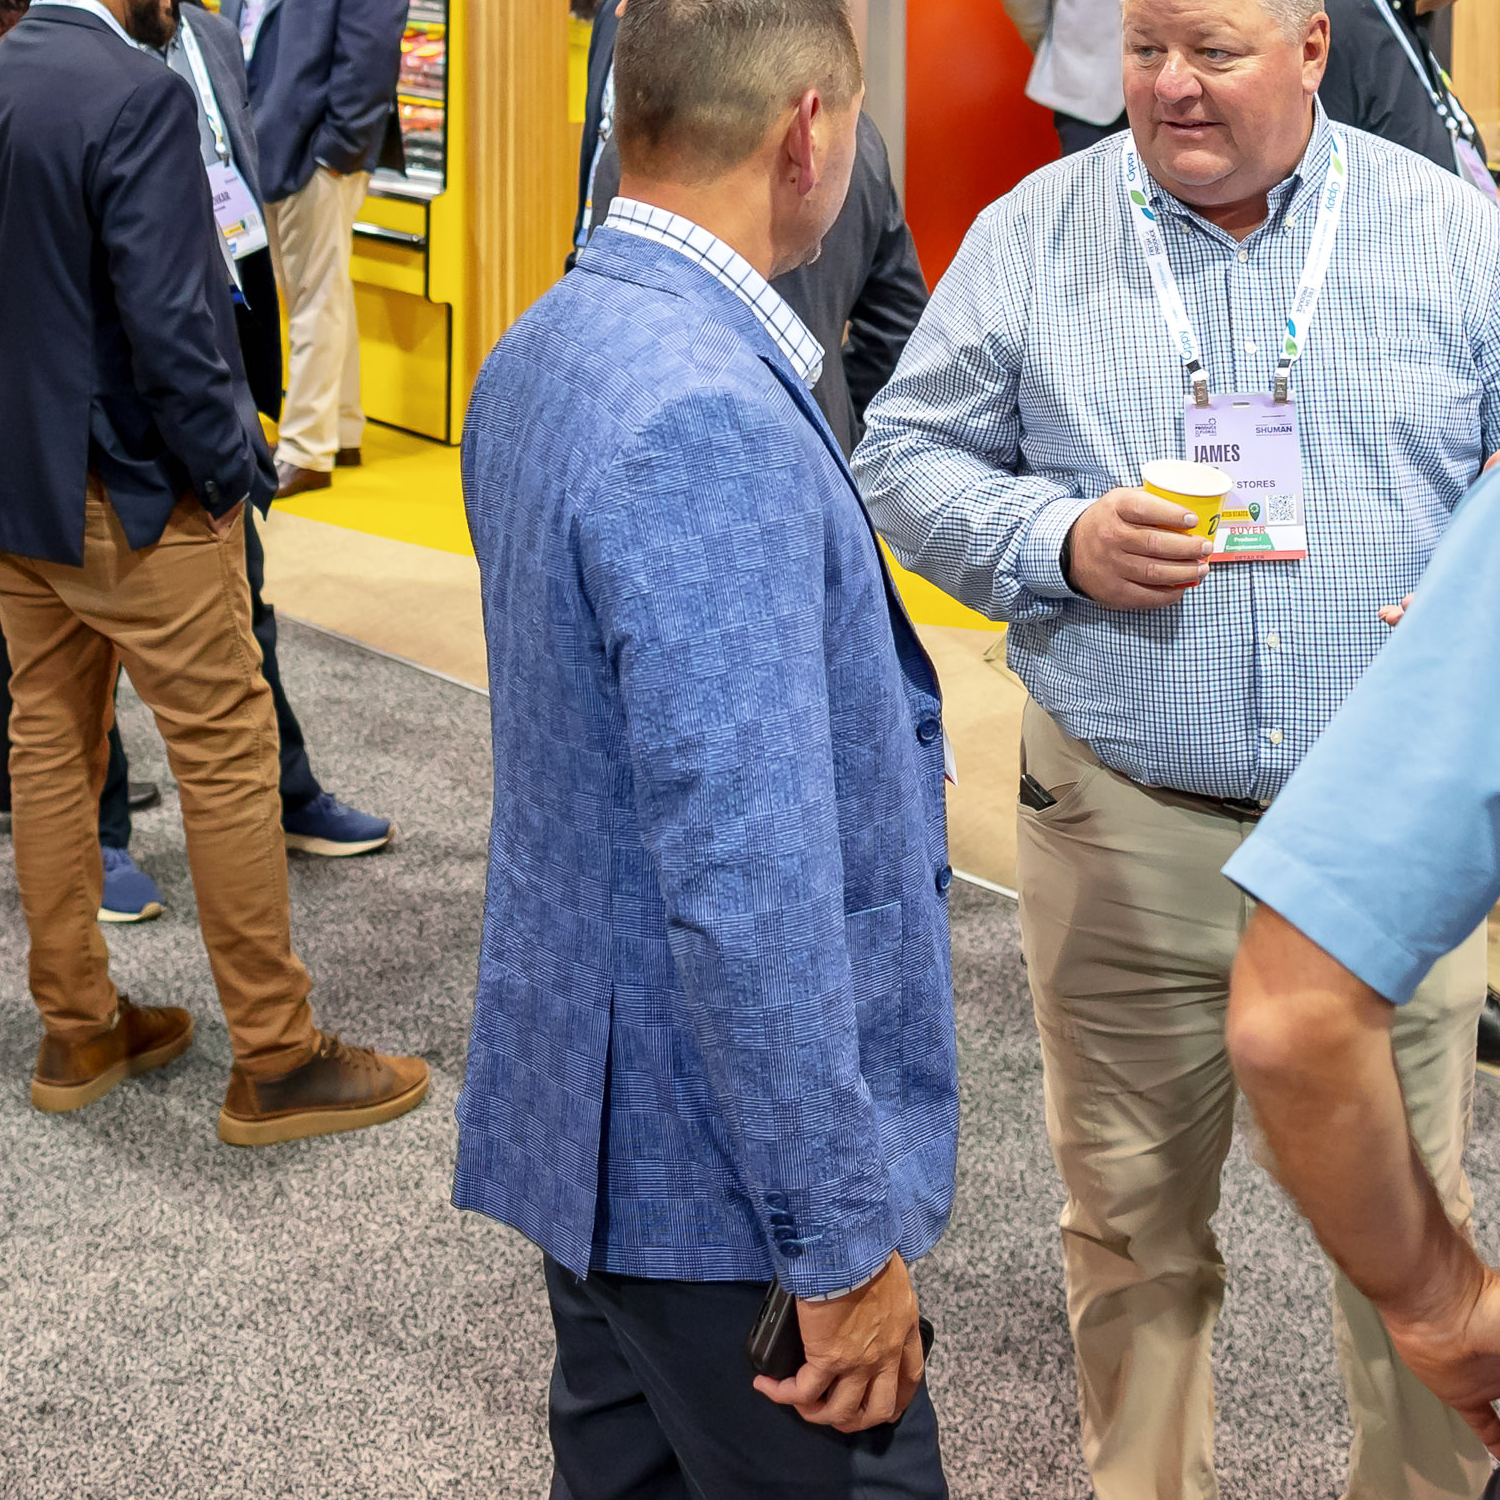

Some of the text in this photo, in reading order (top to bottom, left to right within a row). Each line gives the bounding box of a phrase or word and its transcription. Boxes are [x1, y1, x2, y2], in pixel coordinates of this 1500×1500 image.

[1127, 151, 1136, 182] Oppy
[1326, 181, 1341, 213] Oppy
[1177, 330, 1193, 361] Oppy
[1255, 425, 1293, 434] SHUMAN
[1194, 443, 1240, 463] JAMES
[1236, 479, 1276, 489] STORES
[1229, 526, 1266, 535] BUYER
